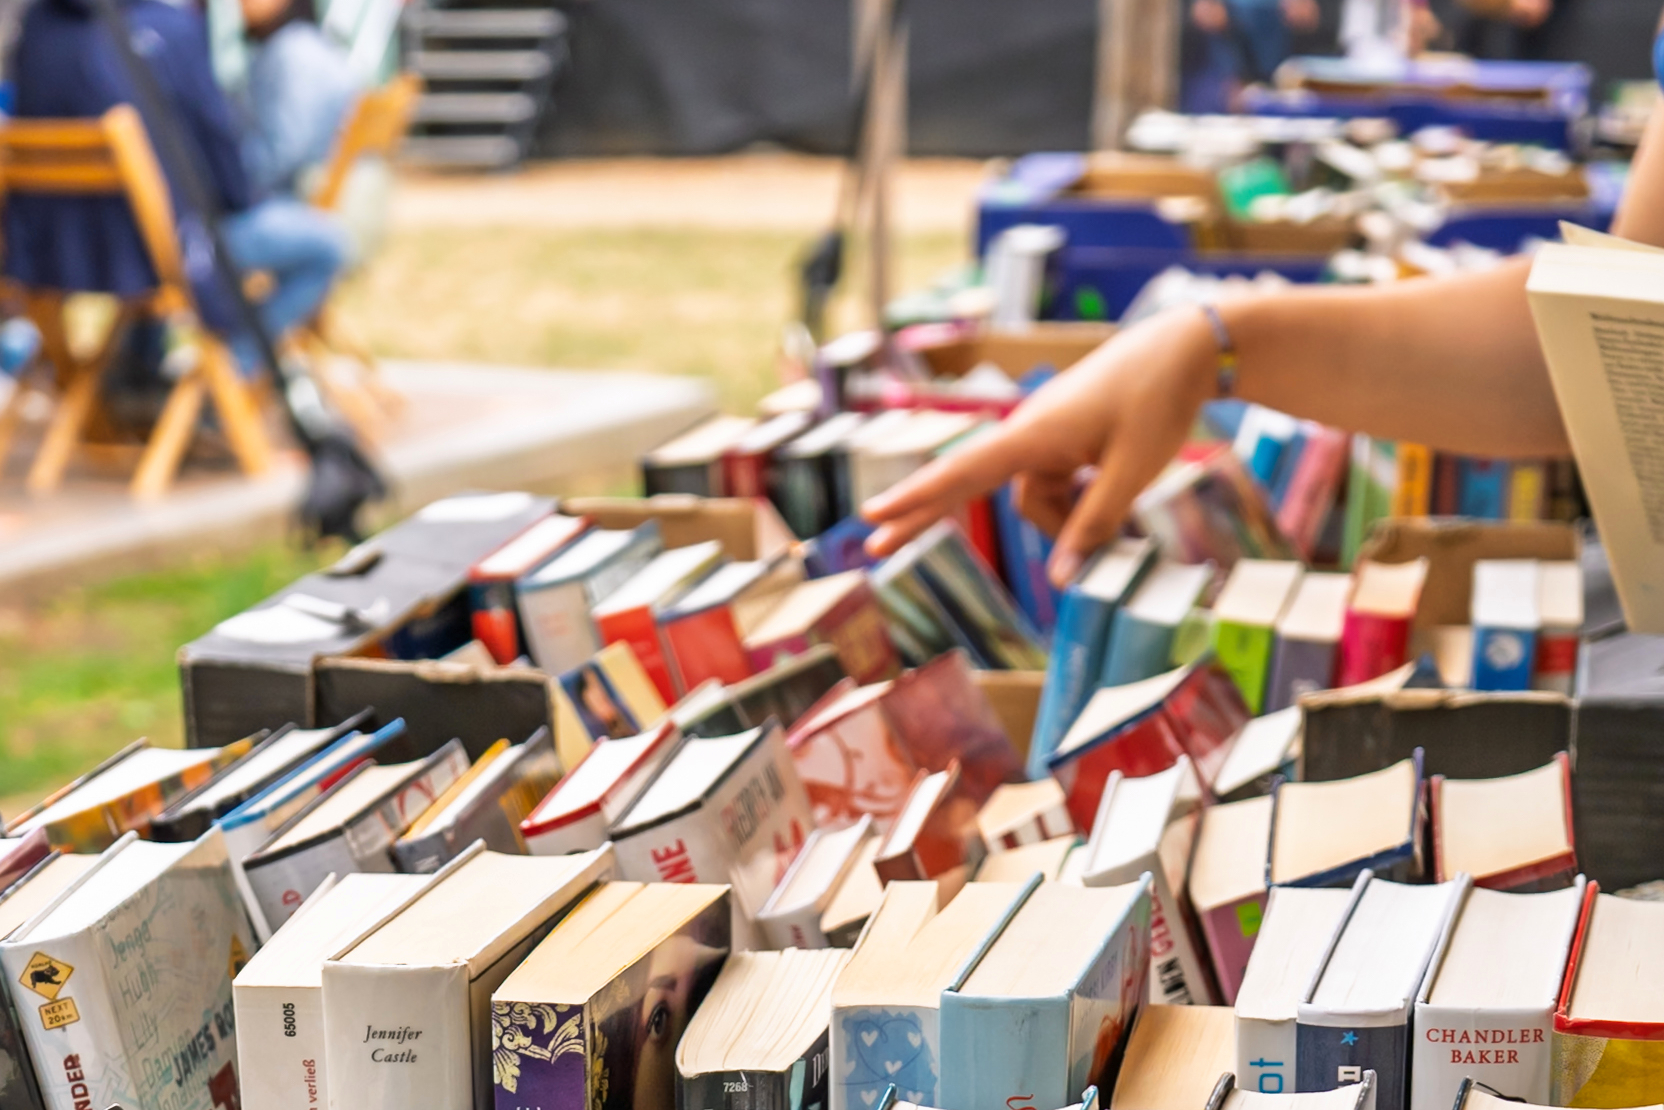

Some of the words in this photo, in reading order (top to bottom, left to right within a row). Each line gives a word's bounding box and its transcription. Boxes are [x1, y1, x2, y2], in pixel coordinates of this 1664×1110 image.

[45, 1002, 69, 1016] NEXT
[283, 1003, 296, 1037] 65005
[362, 1024, 423, 1044] Jennifer
[1426, 1028, 1545, 1044] CHANDLER
[173, 1022, 217, 1088] JAMES
[371, 1047, 418, 1063] Castle
[1450, 1050, 1519, 1064] BAKER
[302, 1059, 318, 1104] verließ
[723, 1082, 748, 1093] 7268
